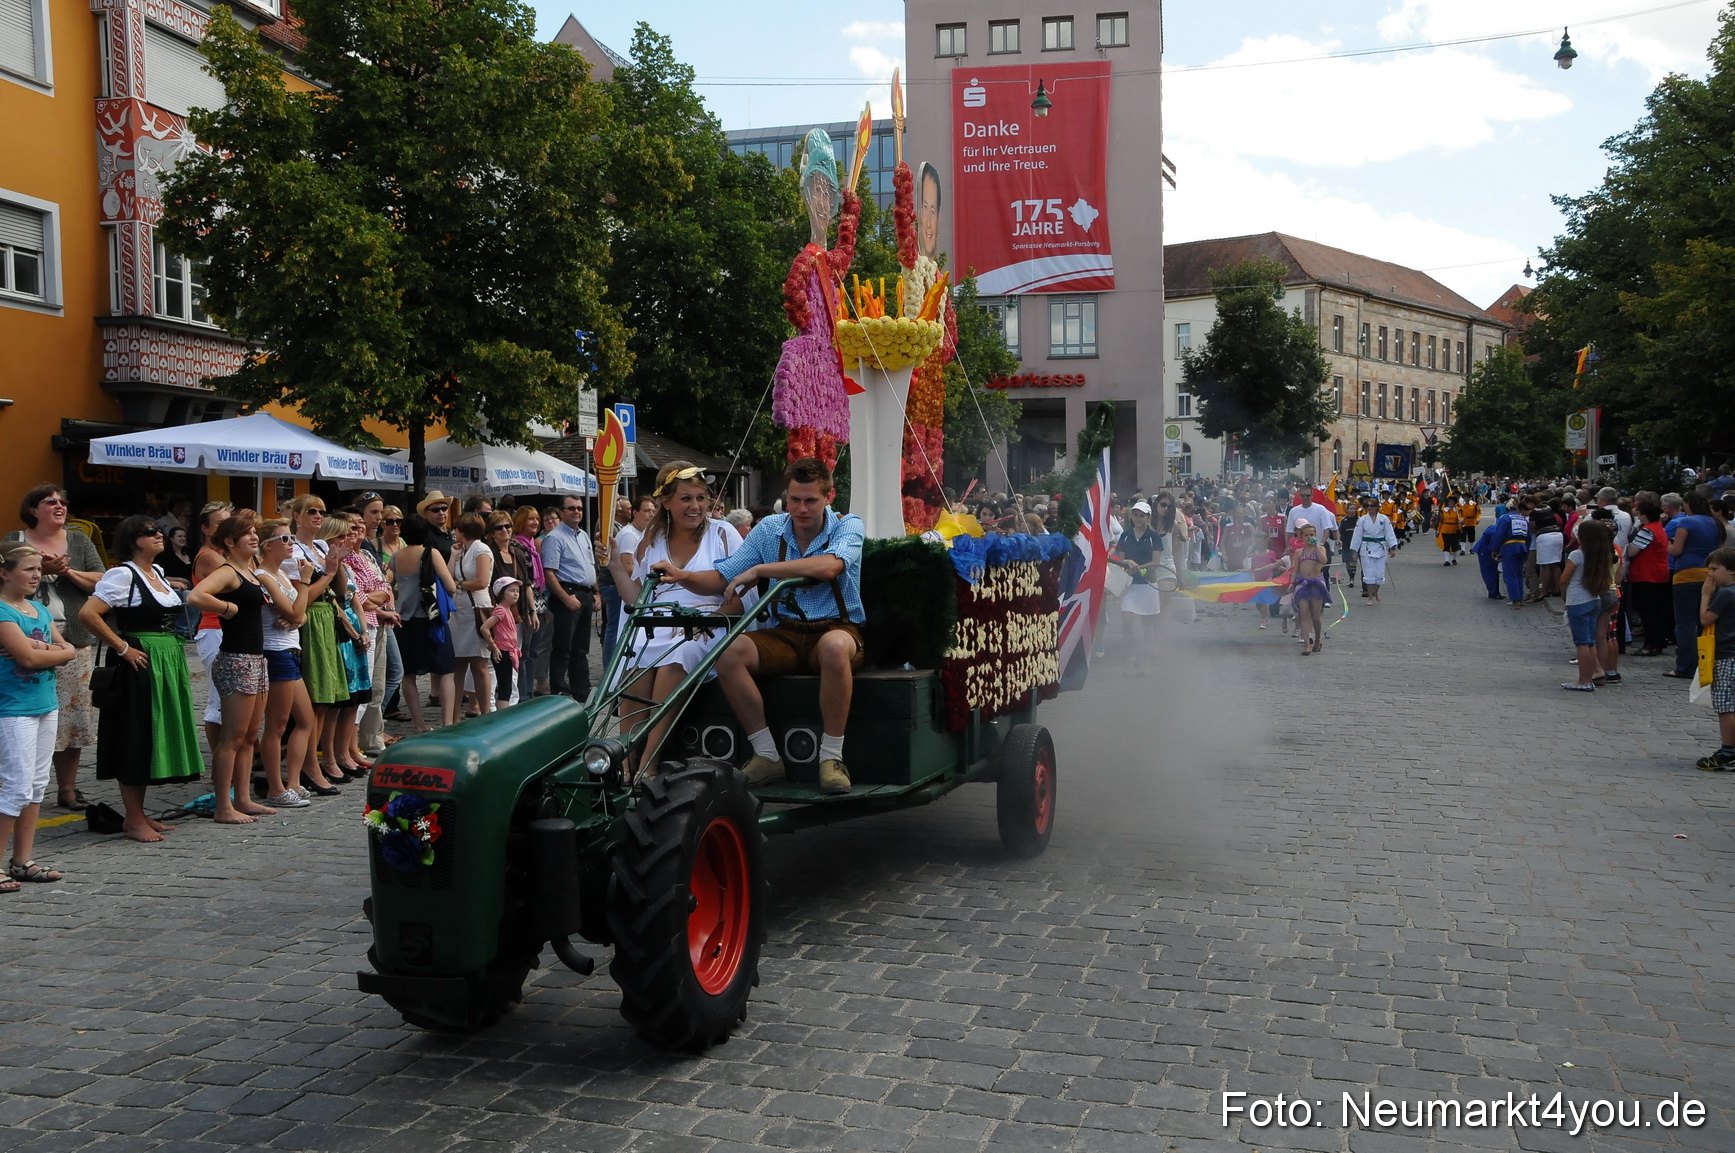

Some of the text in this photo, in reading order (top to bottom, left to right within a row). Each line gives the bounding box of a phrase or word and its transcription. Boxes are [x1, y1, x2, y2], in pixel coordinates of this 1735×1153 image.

[963, 120, 1020, 138] Danke
[963, 143, 1057, 157] für Ihr Vertrauen
[963, 159, 1048, 173] und Ihre Treue.
[1010, 198, 1064, 222] 175
[1012, 221, 1064, 236] JAHRE
[1012, 242, 1043, 250] Sparkasse
[105, 443, 172, 459] Winkler Bräu
[217, 448, 287, 465] Winkler Bräu
[327, 455, 361, 471] Winkler Bräu
[1601, 456, 1614, 464] WC
[452, 466, 469, 478] Bräu
[494, 468, 537, 480] Winkler Bräu
[559, 472, 597, 489] Winkler Bäu
[377, 768, 448, 789] Holder
